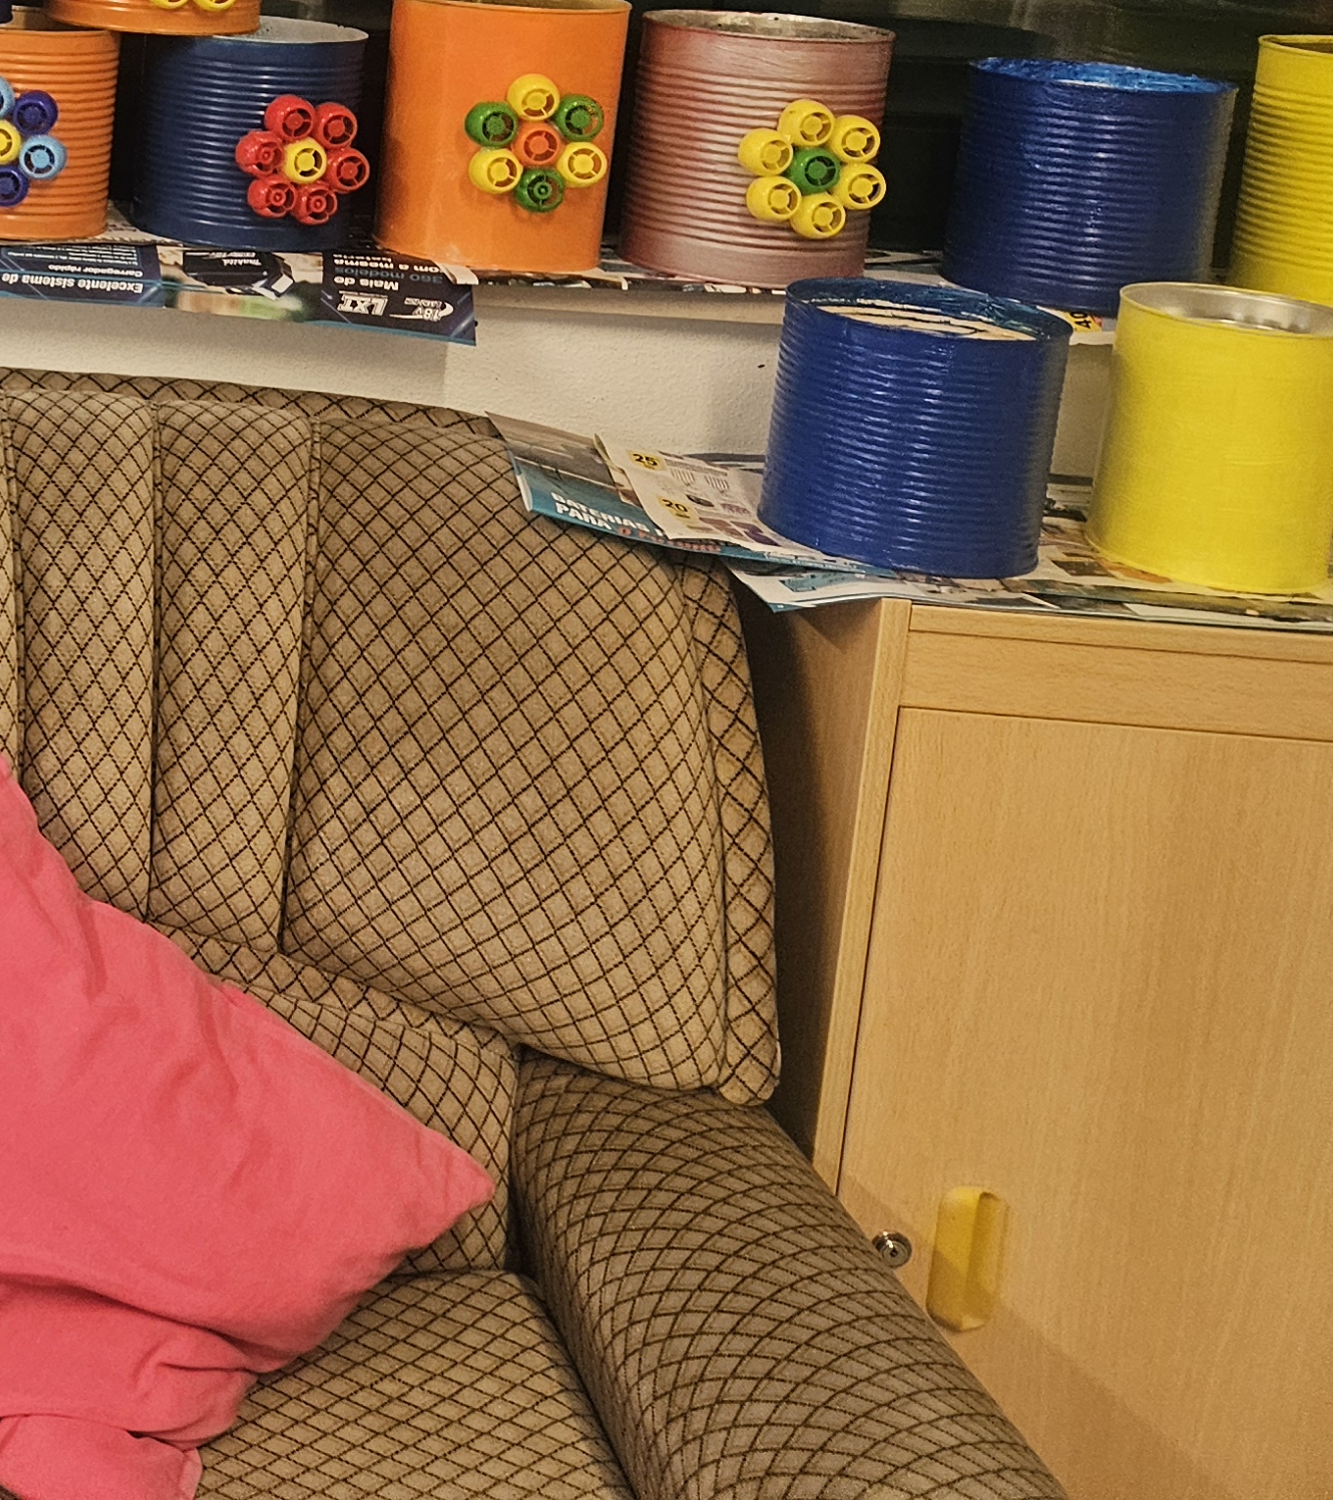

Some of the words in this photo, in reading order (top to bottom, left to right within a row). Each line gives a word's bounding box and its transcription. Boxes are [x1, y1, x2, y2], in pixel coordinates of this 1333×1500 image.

[48, 264, 82, 273] rápido
[82, 267, 144, 278] Carregador
[414, 265, 443, 274] om
[1, 273, 19, 285] de
[21, 274, 75, 288] sistema
[333, 276, 356, 287] de
[359, 278, 399, 291] Mais
[77, 279, 144, 294] Excelente
[337, 294, 389, 316] LXT
[633, 453, 658, 467] 25
[662, 499, 688, 513] 20
[555, 502, 612, 530] PARA
